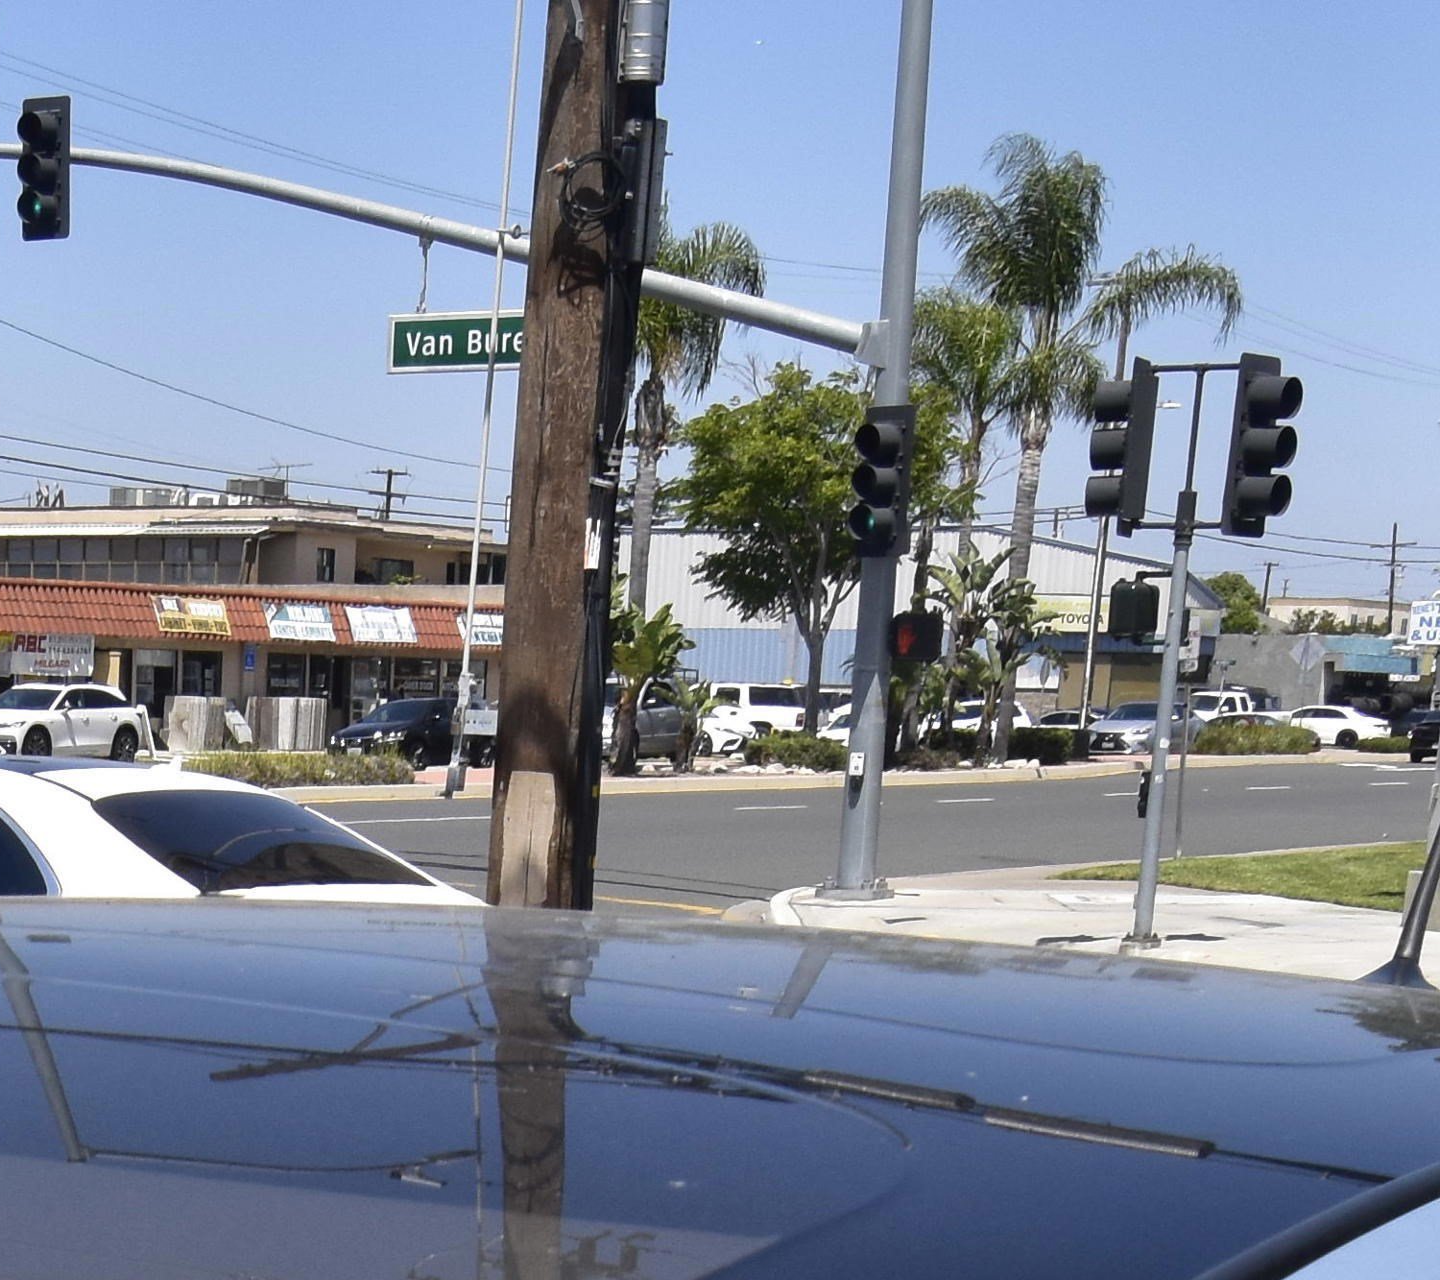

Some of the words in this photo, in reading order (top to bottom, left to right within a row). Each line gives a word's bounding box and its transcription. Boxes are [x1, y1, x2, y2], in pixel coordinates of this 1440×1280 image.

[406, 331, 453, 356] Van
[1060, 613, 1104, 625] TOYOA
[1411, 630, 1422, 641] &
[14, 634, 47, 653] ABC
